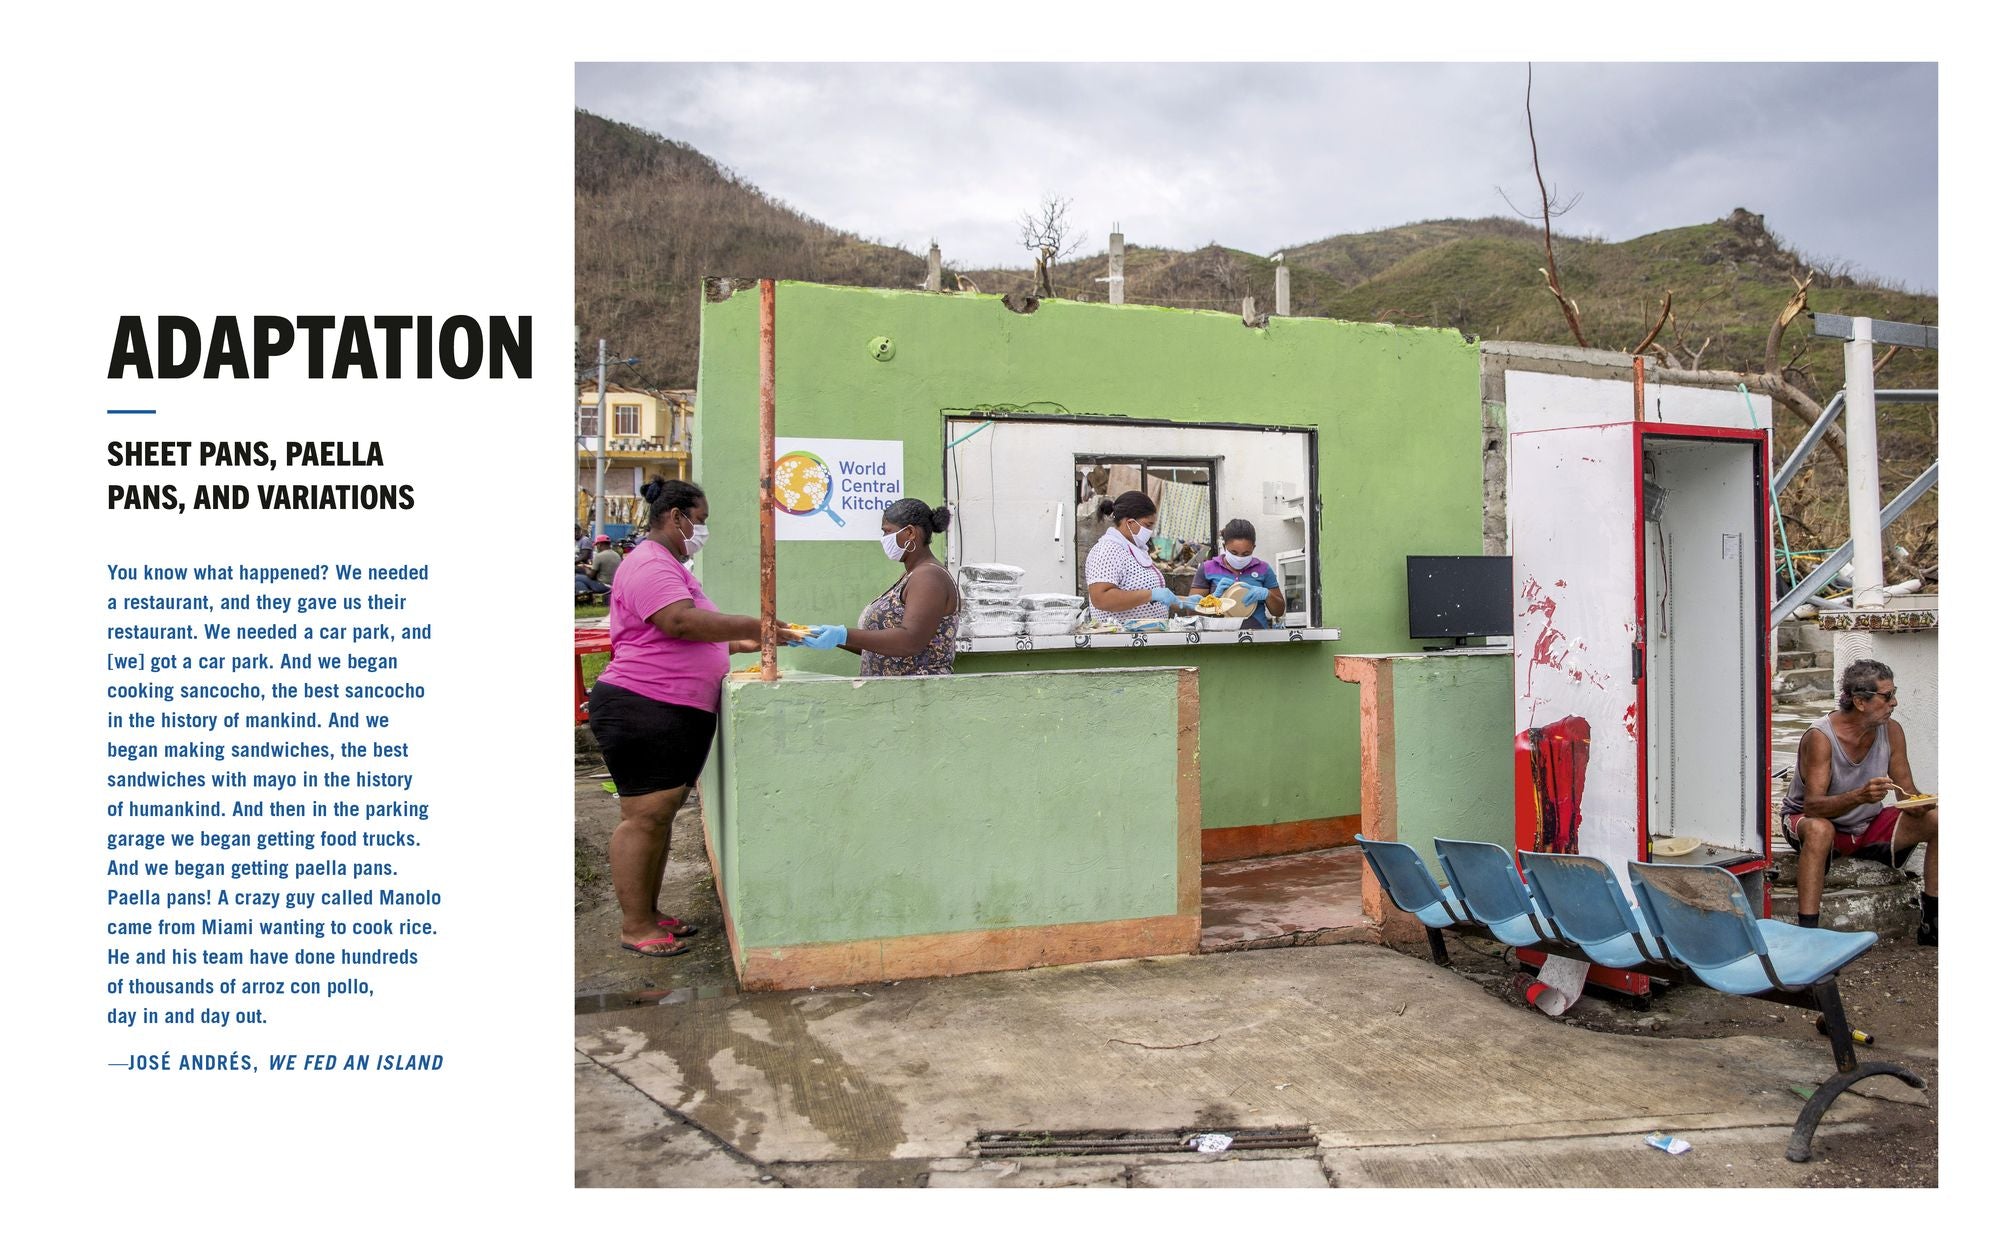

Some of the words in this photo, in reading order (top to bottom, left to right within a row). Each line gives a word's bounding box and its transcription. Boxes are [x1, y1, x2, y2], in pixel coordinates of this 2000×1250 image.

[839, 461, 886, 475] World
[842, 478, 900, 493] Central
[842, 496, 894, 510] Kitche
